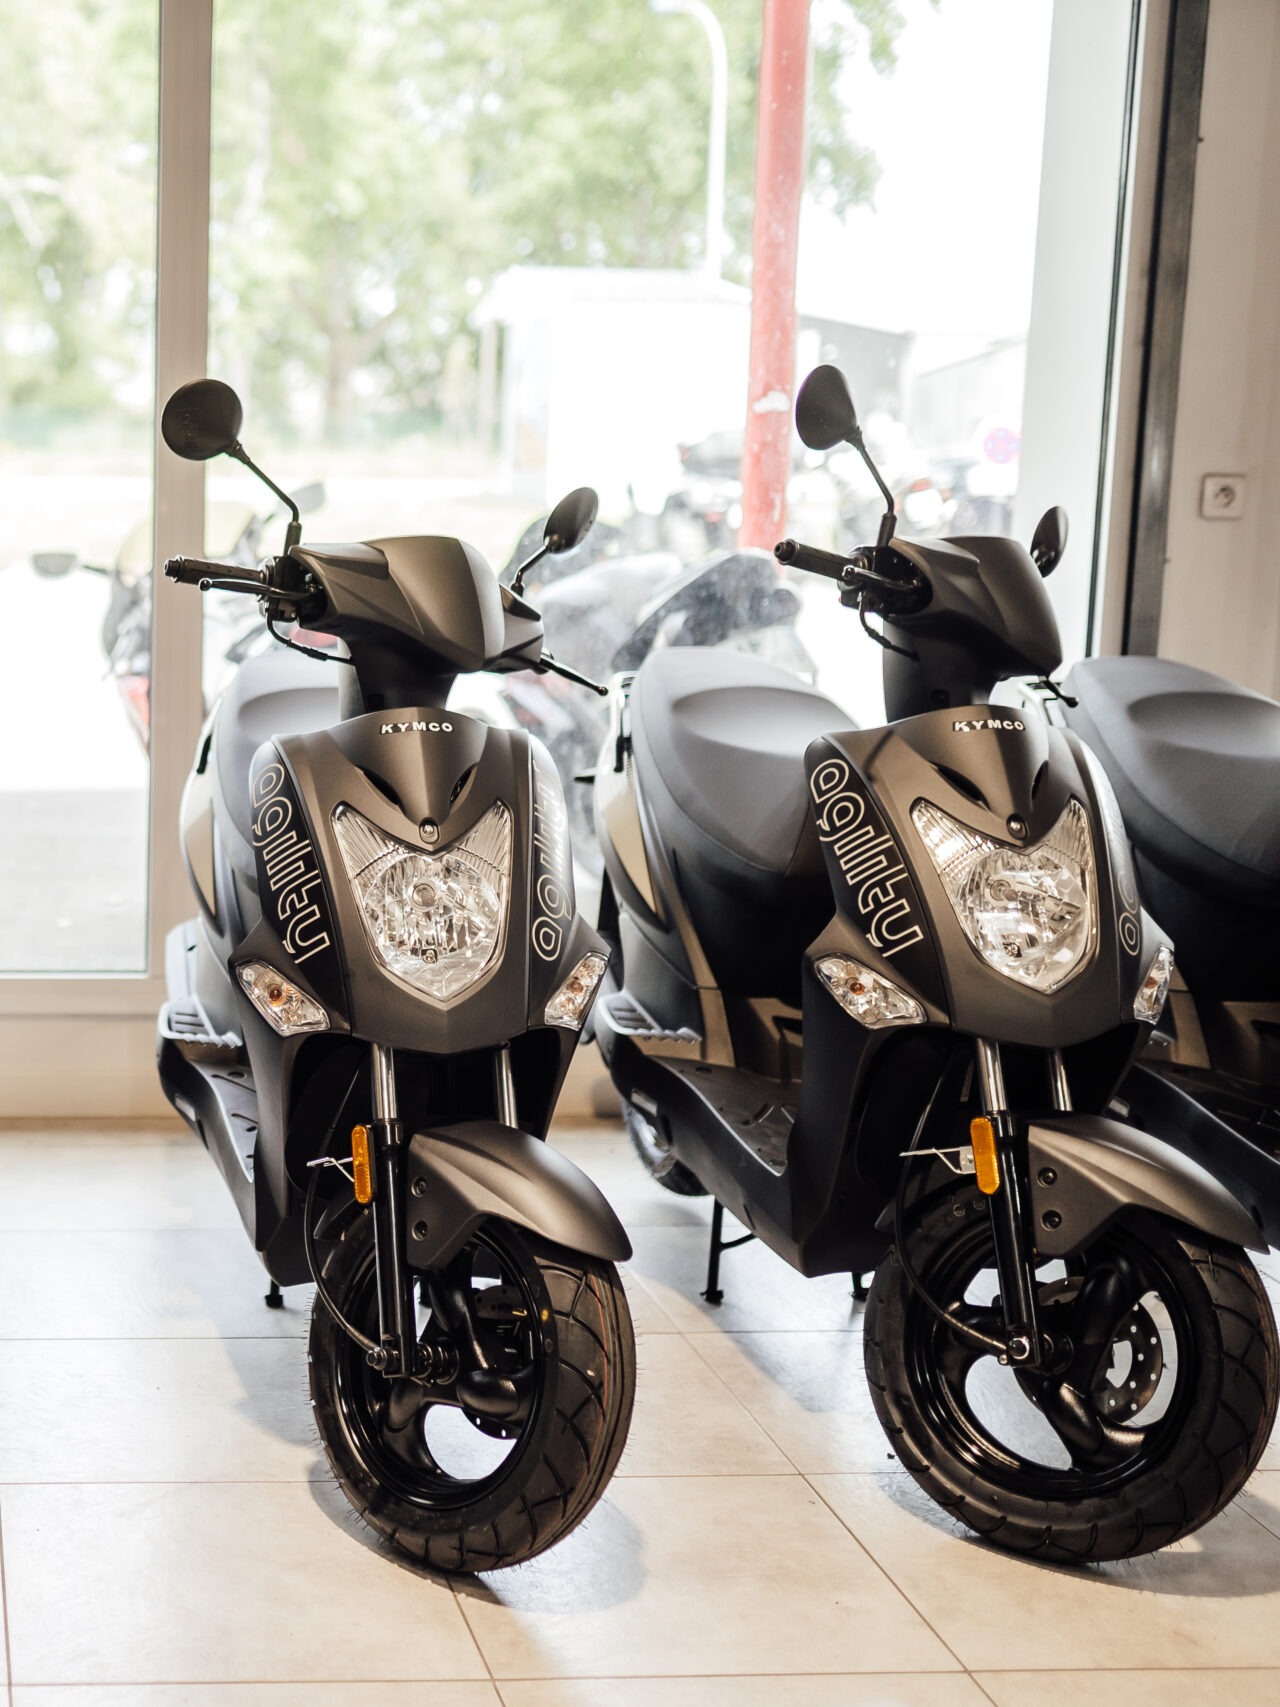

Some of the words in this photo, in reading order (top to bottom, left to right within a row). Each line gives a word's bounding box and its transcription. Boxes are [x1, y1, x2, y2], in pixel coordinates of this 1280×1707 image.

[381, 721, 453, 734] KYMCO
[955, 720, 1024, 732] KYMCO
[252, 763, 331, 964] agility
[810, 758, 924, 957] agility
